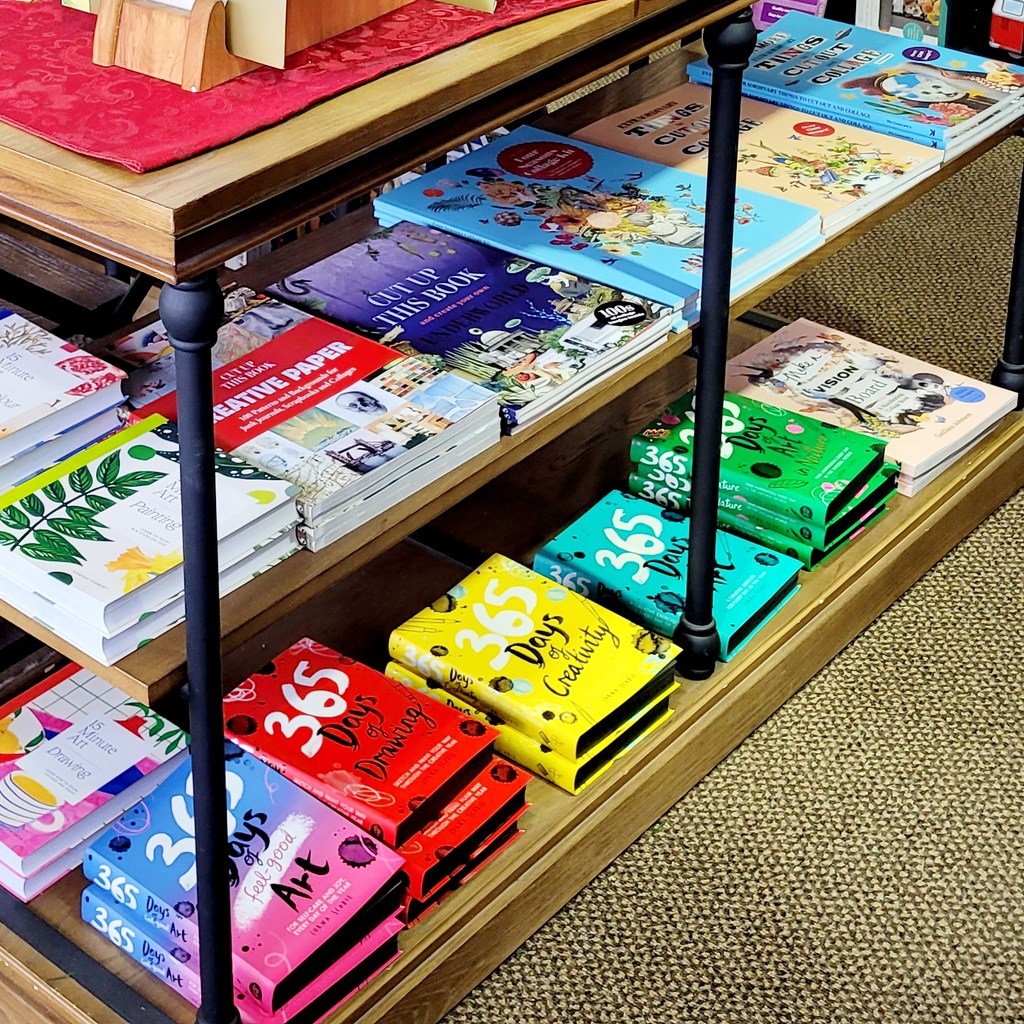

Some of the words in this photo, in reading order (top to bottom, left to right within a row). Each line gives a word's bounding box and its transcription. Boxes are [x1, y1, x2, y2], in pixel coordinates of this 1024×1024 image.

[811, 49, 882, 85] COLLAGE
[367, 278, 413, 308] CUT
[414, 267, 438, 289] UP
[372, 296, 430, 329] THIS
[434, 268, 487, 303] BOOK
[281, 341, 354, 382] PAPER
[814, 365, 860, 393] VISION
[848, 376, 887, 406] Board
[595, 508, 665, 585] 365
[455, 578, 538, 672] 365
[504, 612, 564, 668] Days
[542, 620, 622, 698] Creativity
[264, 660, 350, 758] 365
[317, 694, 383, 752] Days
[46, 746, 92, 781] Drawing
[67, 733, 86, 751] Art
[79, 726, 118, 756] Minute
[354, 703, 438, 782] Drawing
[244, 828, 297, 905] feel-good
[270, 849, 330, 913] Art
[93, 864, 140, 910] 365
[146, 895, 170, 921] Days
[170, 922, 188, 943] Art
[90, 907, 136, 954] 365
[142, 940, 165, 966] Days
[166, 967, 183, 988] Art
